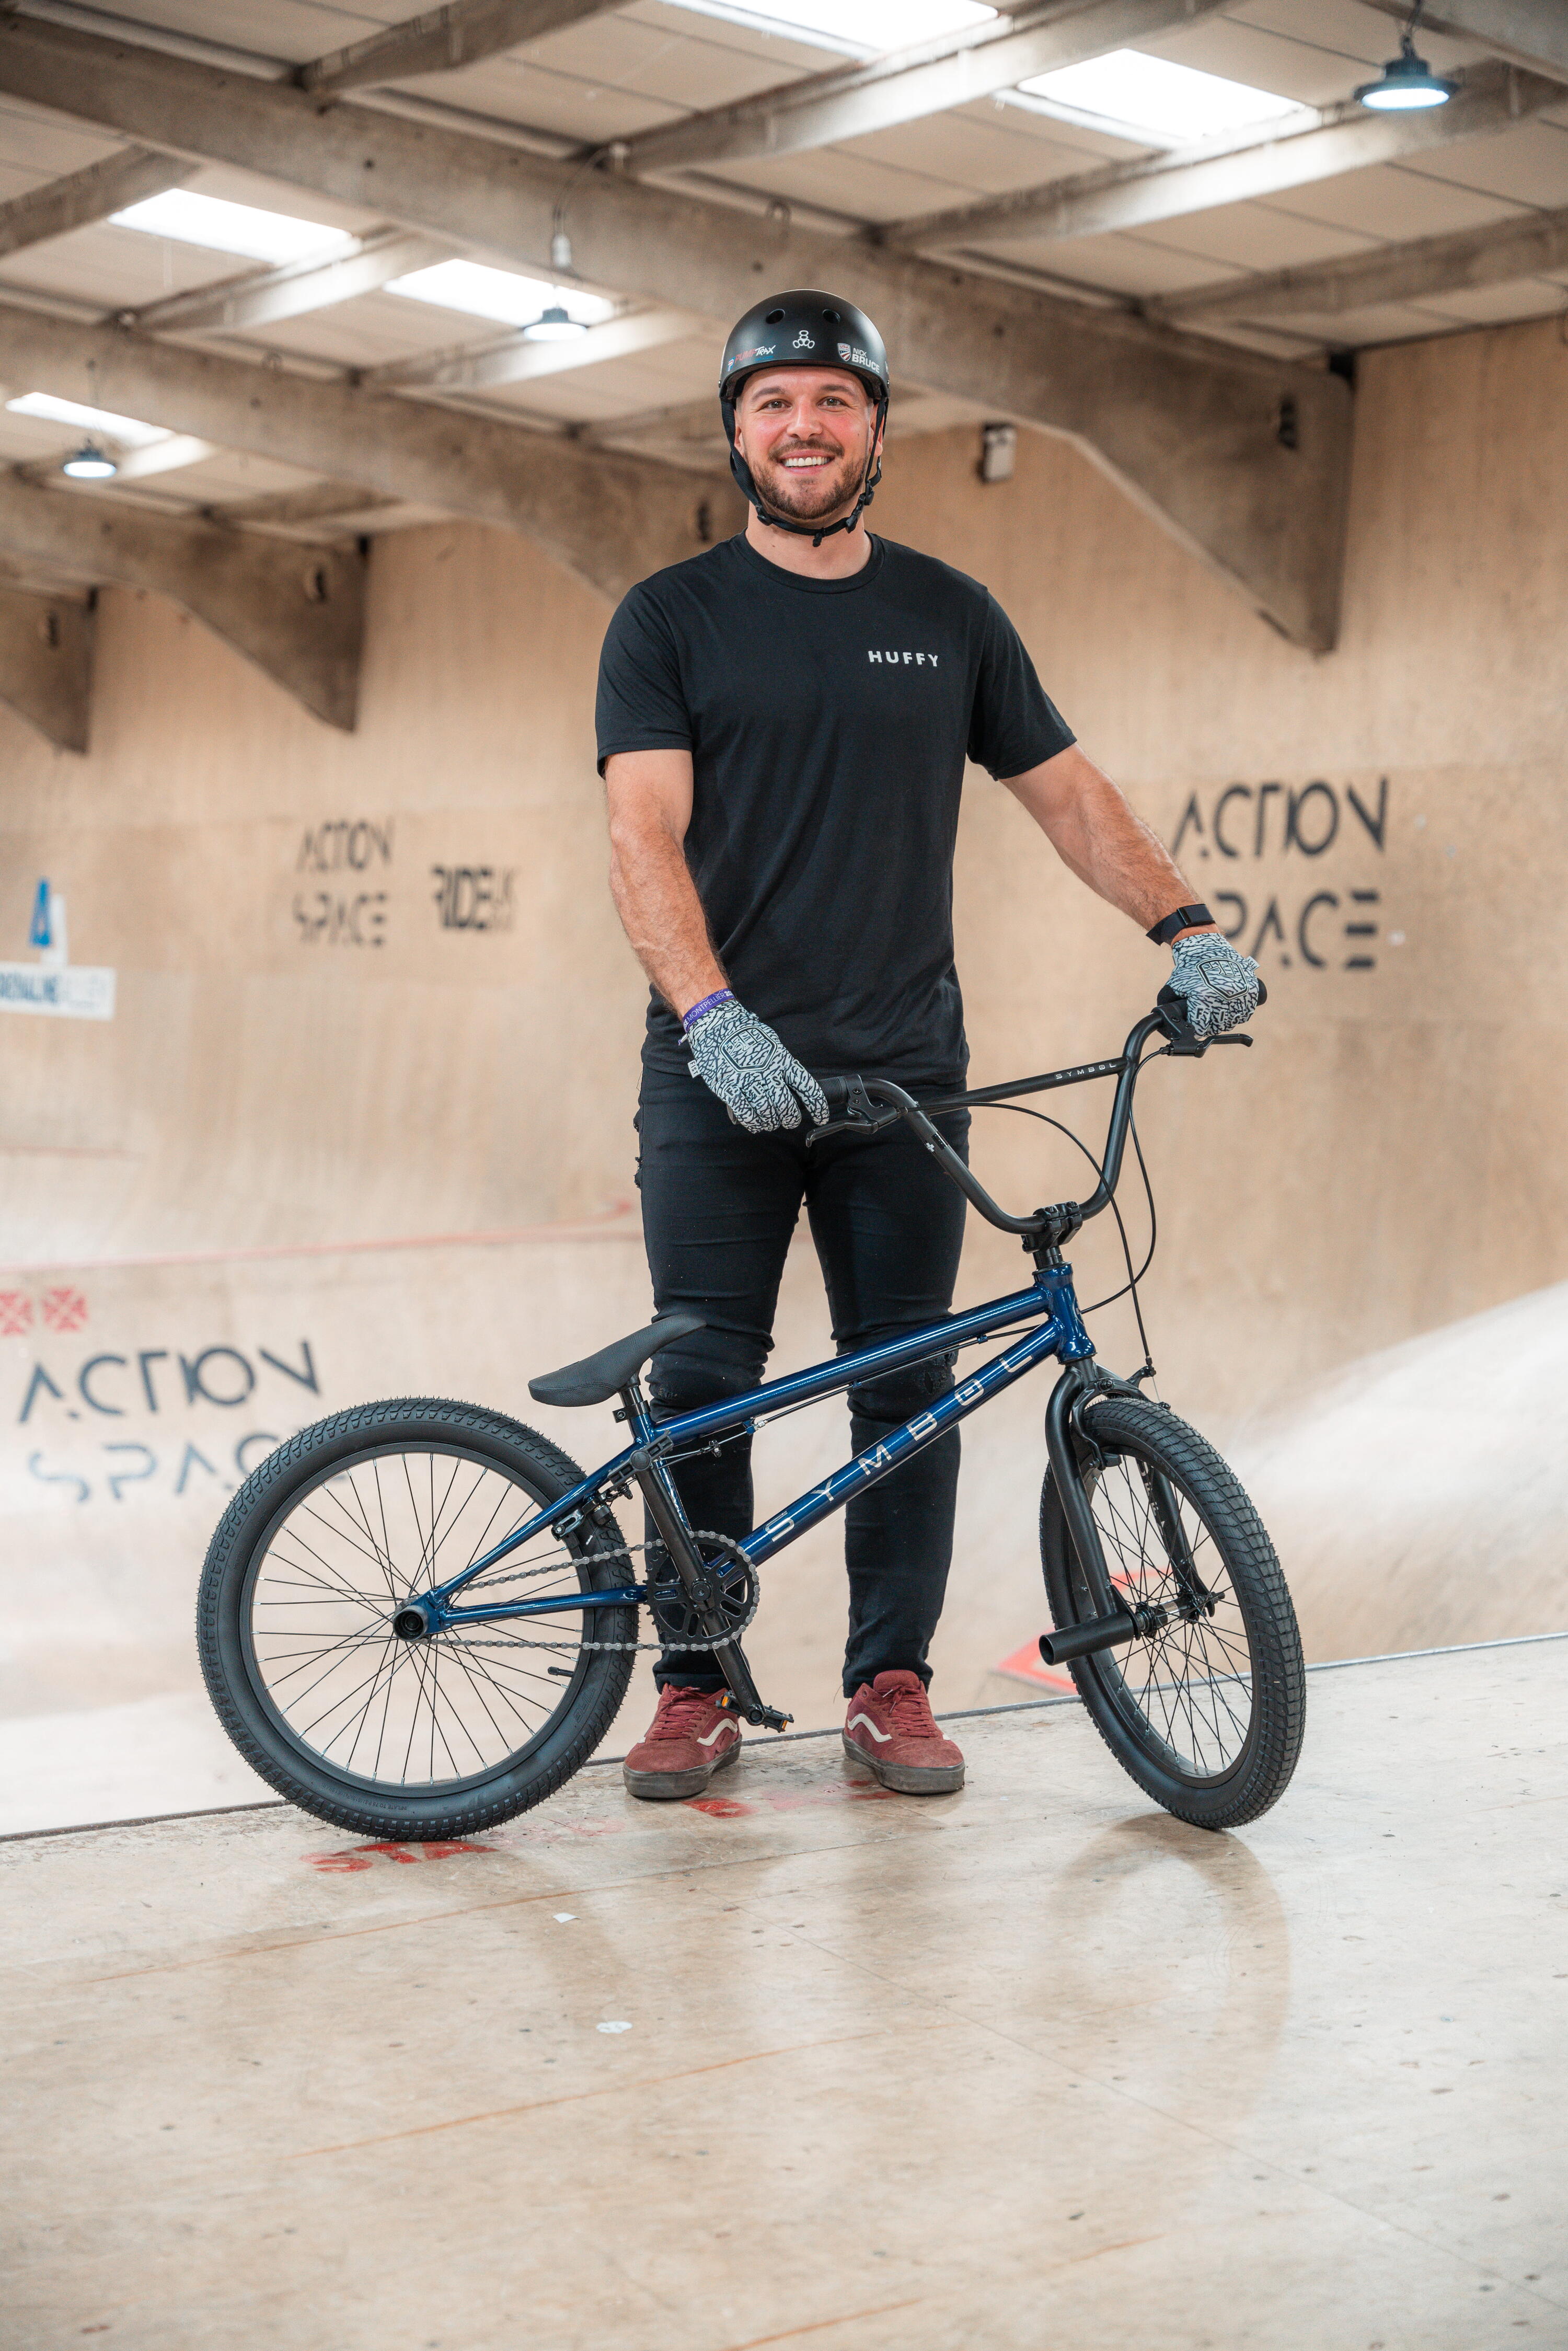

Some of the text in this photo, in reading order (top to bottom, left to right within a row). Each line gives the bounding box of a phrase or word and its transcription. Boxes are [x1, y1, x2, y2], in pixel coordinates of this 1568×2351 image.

[851, 353, 880, 374] BRUCE
[853, 348, 867, 357] NICK
[868, 650, 939, 667] HUFFY
[1171, 776, 1389, 858] ACTION
[1214, 889, 1380, 971] PACE
[686, 993, 726, 1022] MONTPELLIER
[690, 1061, 699, 1075] FIST
[1055, 1063, 1116, 1079] SYMBOL
[18, 1338, 322, 1424] ACTION
[765, 1355, 1033, 1542] SYMBOL
[28, 1429, 293, 1503] SPAC
